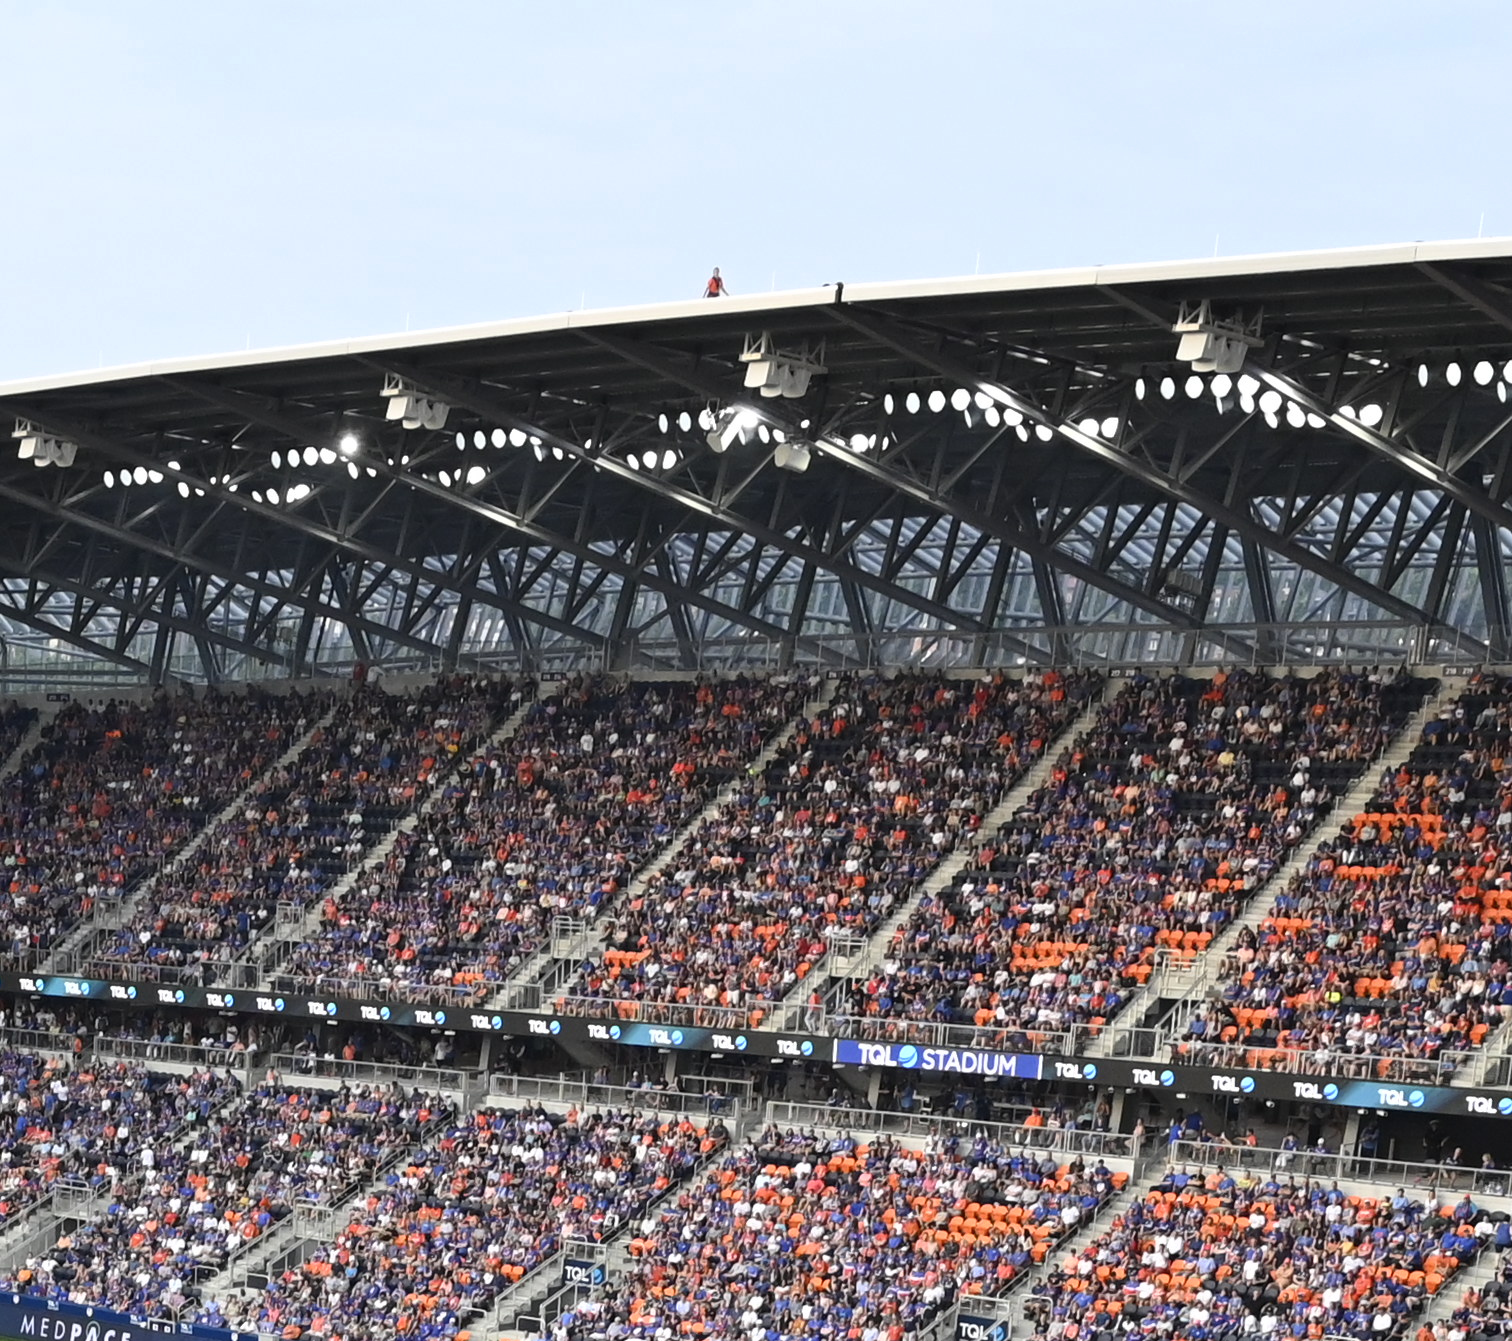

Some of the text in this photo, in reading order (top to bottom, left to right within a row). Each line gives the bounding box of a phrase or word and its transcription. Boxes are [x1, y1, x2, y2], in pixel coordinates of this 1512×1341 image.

[157, 990, 176, 1002] TQL
[255, 998, 276, 1011] TQL
[360, 1006, 381, 1020] TQL
[470, 1015, 492, 1029] TQL
[587, 1025, 610, 1039] TQL
[647, 1027, 672, 1046] TQL
[711, 1035, 736, 1049] TQL
[776, 1040, 801, 1055] TQL
[858, 1043, 1016, 1076] TQL STADIUM
[1054, 1062, 1083, 1079] TQL
[1131, 1069, 1160, 1085] TQL
[1210, 1075, 1240, 1092] TQL
[1292, 1082, 1323, 1099] TQL
[1376, 1088, 1409, 1106] TQL
[1465, 1096, 1498, 1113] TQL
[564, 1265, 589, 1283] TQL
